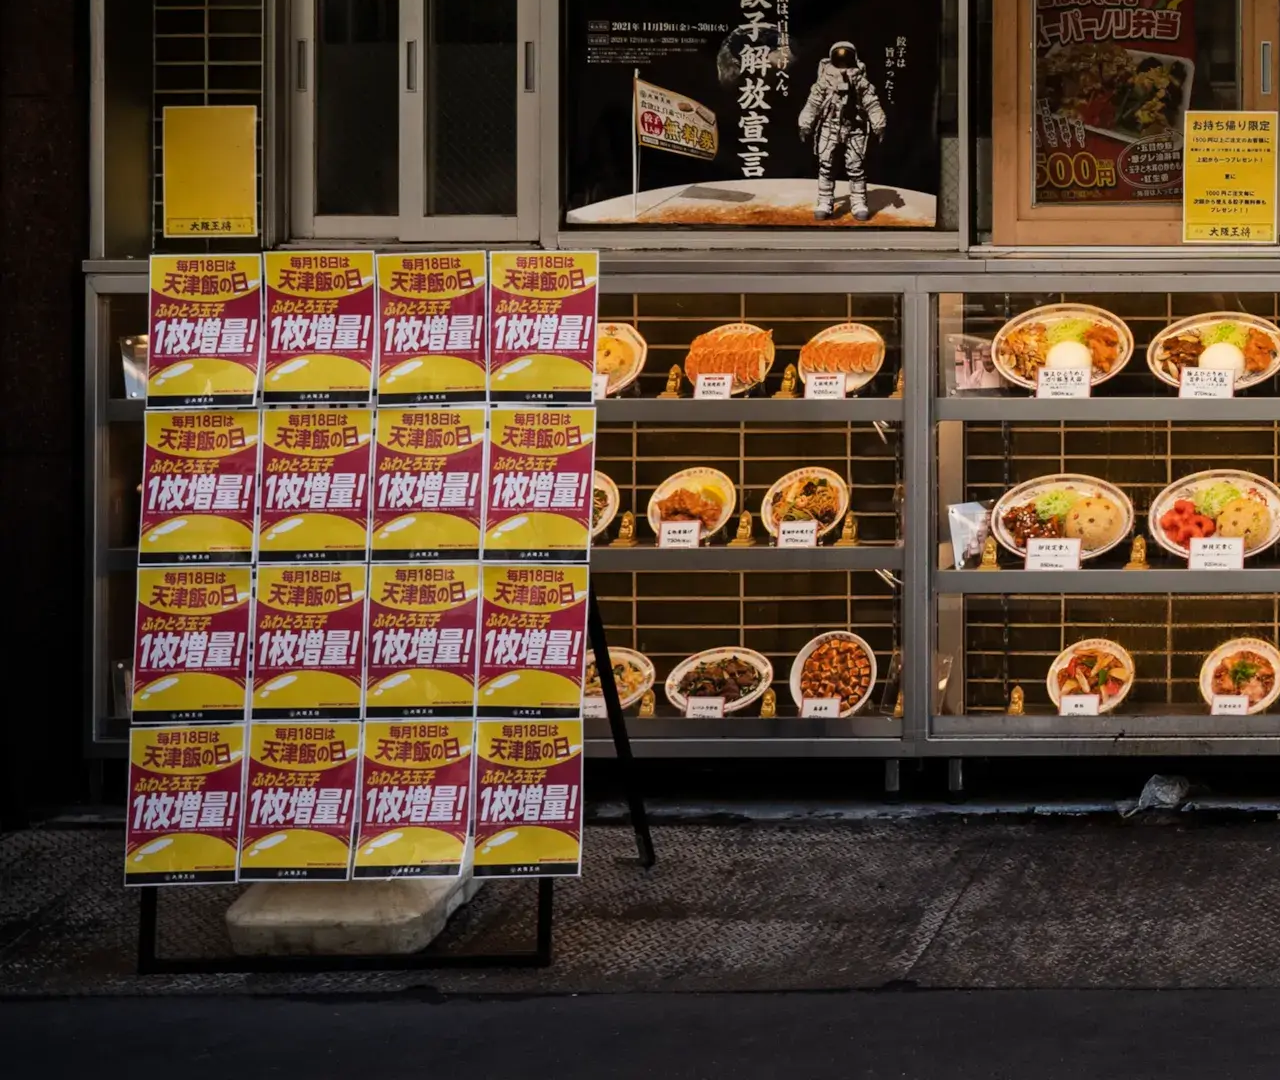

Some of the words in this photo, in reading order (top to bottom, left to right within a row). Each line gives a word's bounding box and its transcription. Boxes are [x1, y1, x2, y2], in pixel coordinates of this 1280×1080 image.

[1193, 120, 1270, 132] お持ち帰り限定
[1209, 227, 1251, 237] 大阪王将
[176, 260, 236, 271] 毎月18日は
[290, 257, 349, 268] 毎月18日は
[402, 257, 461, 270] 毎月18日は
[516, 256, 574, 268] 毎月18日は
[163, 272, 249, 295] 天津飯の日
[277, 269, 362, 292] 天津飯の日
[390, 269, 474, 293] 天津飯の日
[503, 269, 585, 291] 天津飯の日
[155, 304, 225, 317] ふわとろ玉子
[271, 299, 338, 313] ふわとろ玉子
[384, 300, 450, 314] ふわとろ玉子
[495, 299, 562, 313] ふわとろ玉子
[155, 319, 257, 354] 1枚増量!
[271, 314, 371, 350] 1枚増量!
[384, 315, 483, 352] 1枚増量!
[495, 314, 592, 350] 1枚増量!
[172, 415, 234, 427] 毎月18日は
[289, 414, 348, 426] 毎月18日は
[402, 413, 461, 425] 毎月18日は
[514, 413, 571, 425] 毎月18日は
[158, 427, 245, 451] 天津飯の日
[274, 427, 359, 449] 天津飯の日
[387, 426, 473, 448] 天津飯の日
[501, 426, 582, 448] 天津飯の日
[150, 459, 220, 473] ふわとろ玉子
[267, 458, 334, 472] ふわとろ玉子
[380, 457, 447, 471] ふわとろ玉子
[494, 457, 558, 471] ふわとろ玉子
[148, 474, 252, 510] 1枚増量!
[266, 473, 366, 508] 1枚増量!
[378, 472, 479, 508] 1枚増量!
[492, 472, 588, 507] 1枚増量!
